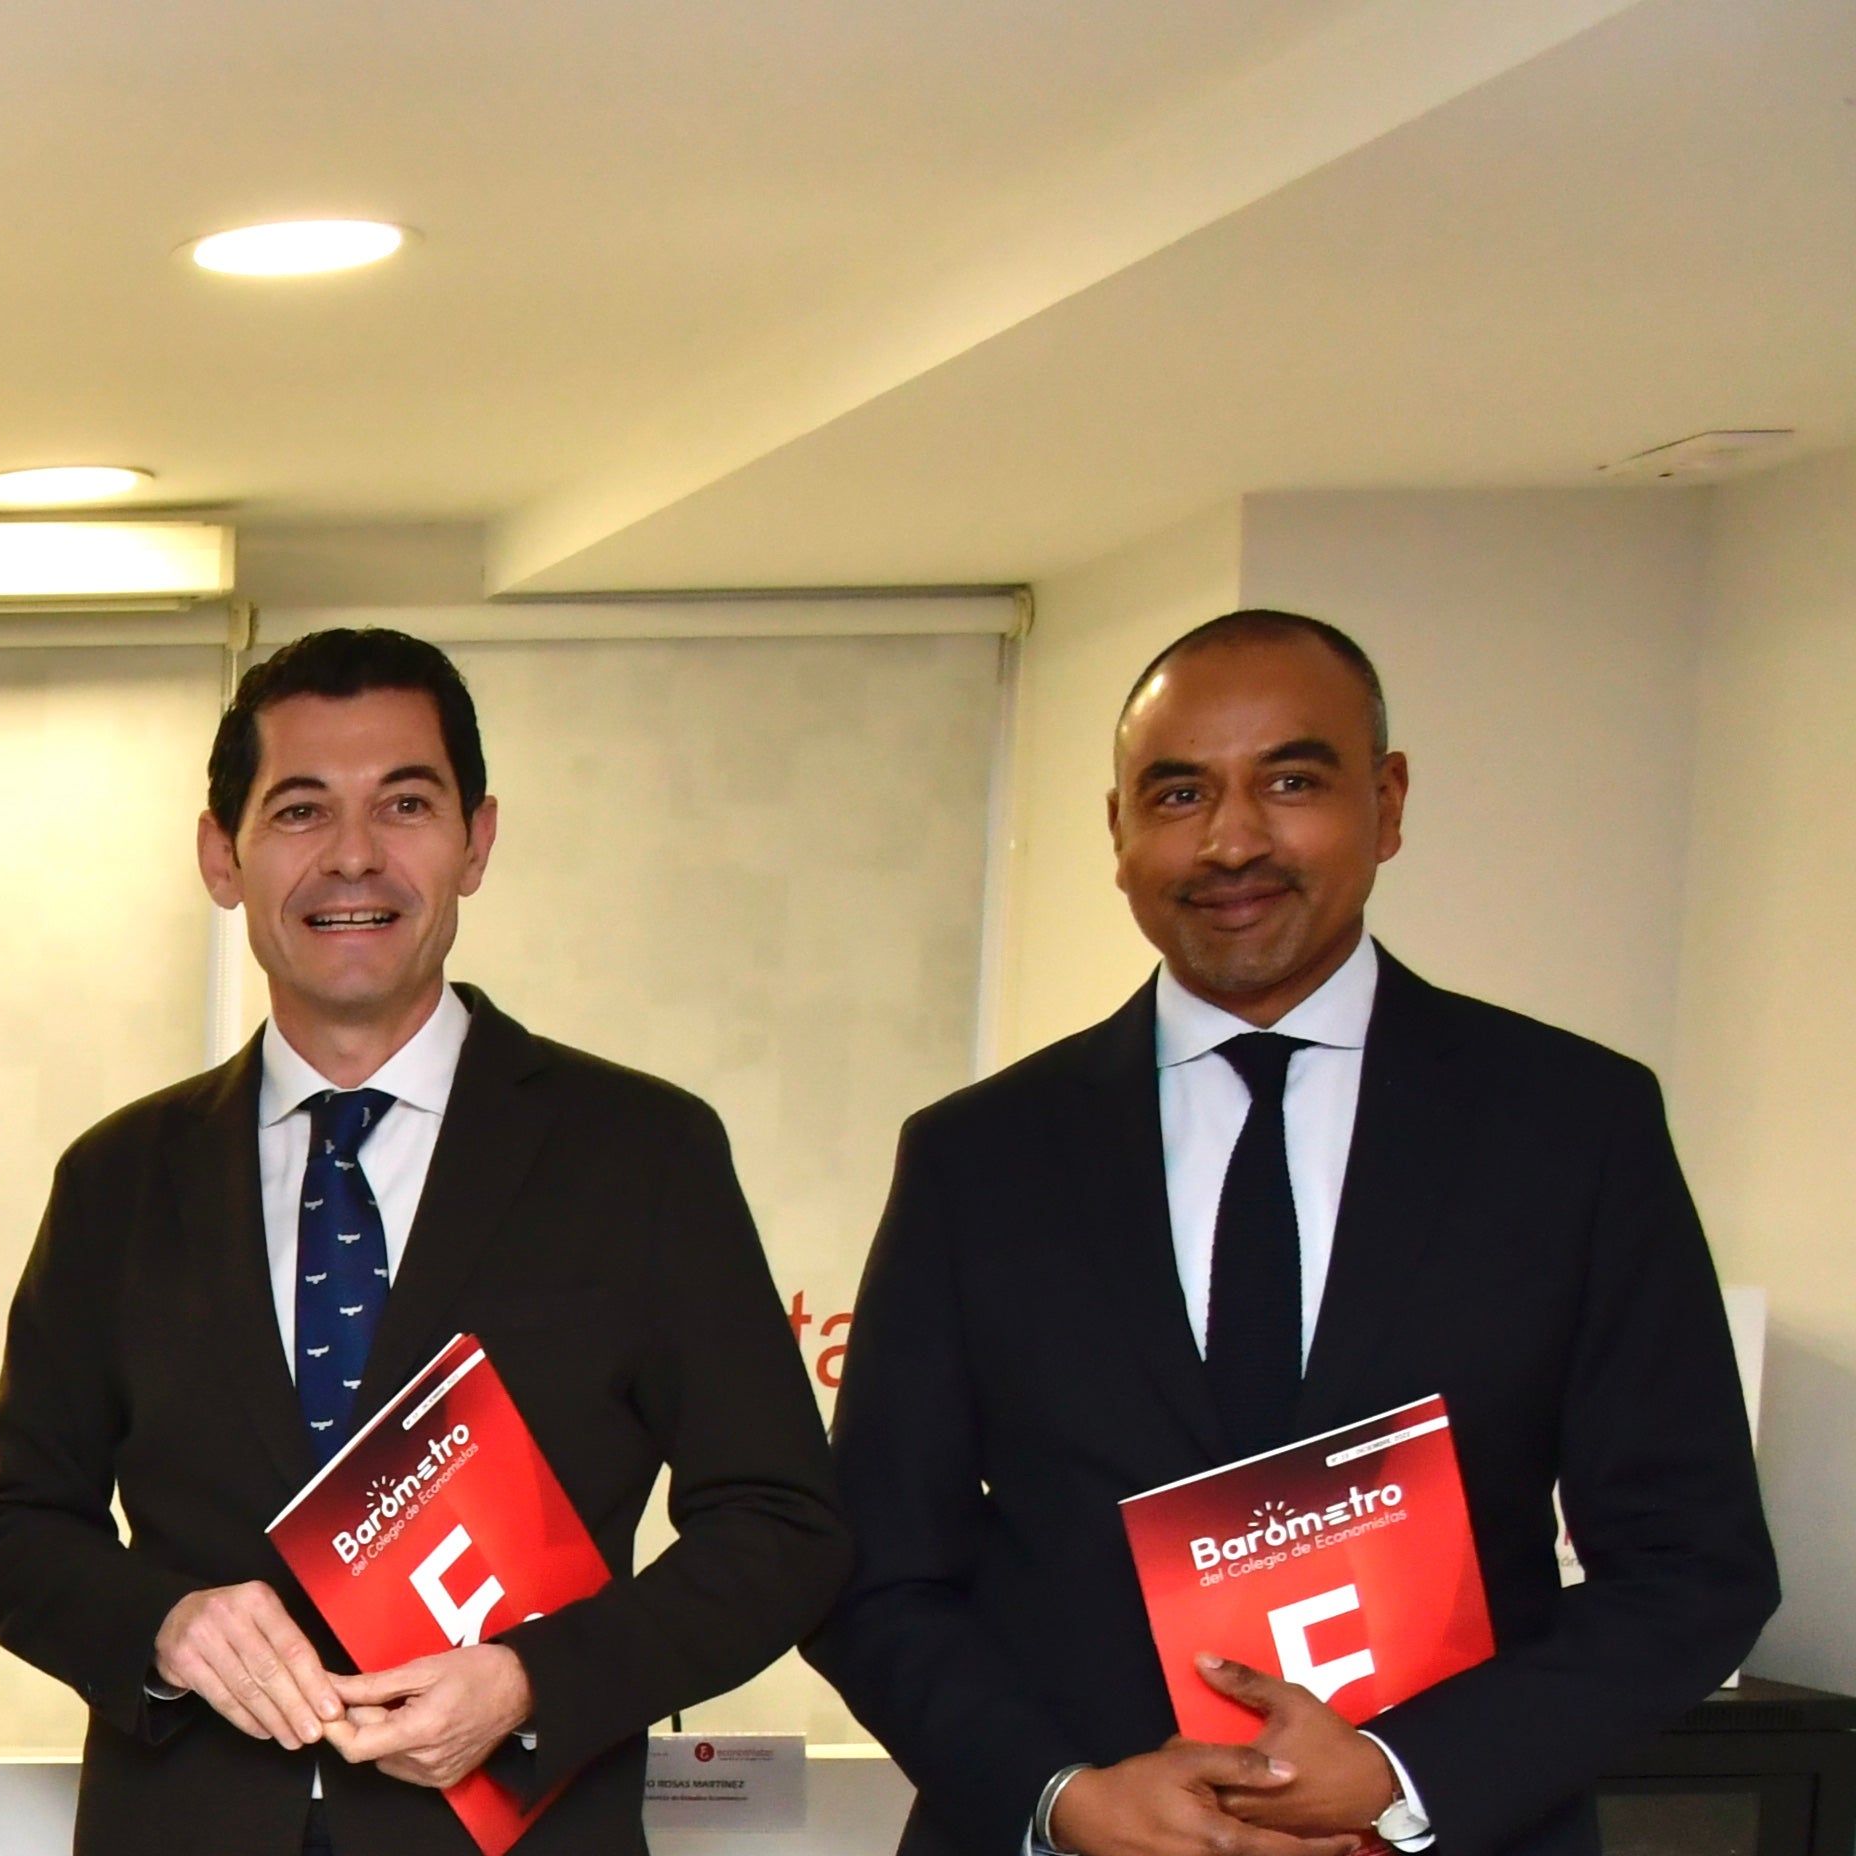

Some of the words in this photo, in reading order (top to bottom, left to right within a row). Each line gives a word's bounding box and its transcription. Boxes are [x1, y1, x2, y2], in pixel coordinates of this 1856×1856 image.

[350, 1553, 367, 1577] del
[367, 1519, 405, 1559] Colegio
[405, 1503, 420, 1521] de
[418, 1443, 479, 1505] Economistas
[1199, 1567, 1224, 1588] del
[1227, 1548, 1288, 1579] Colegio
[1290, 1540, 1312, 1559] de
[1314, 1507, 1407, 1550] Economistas
